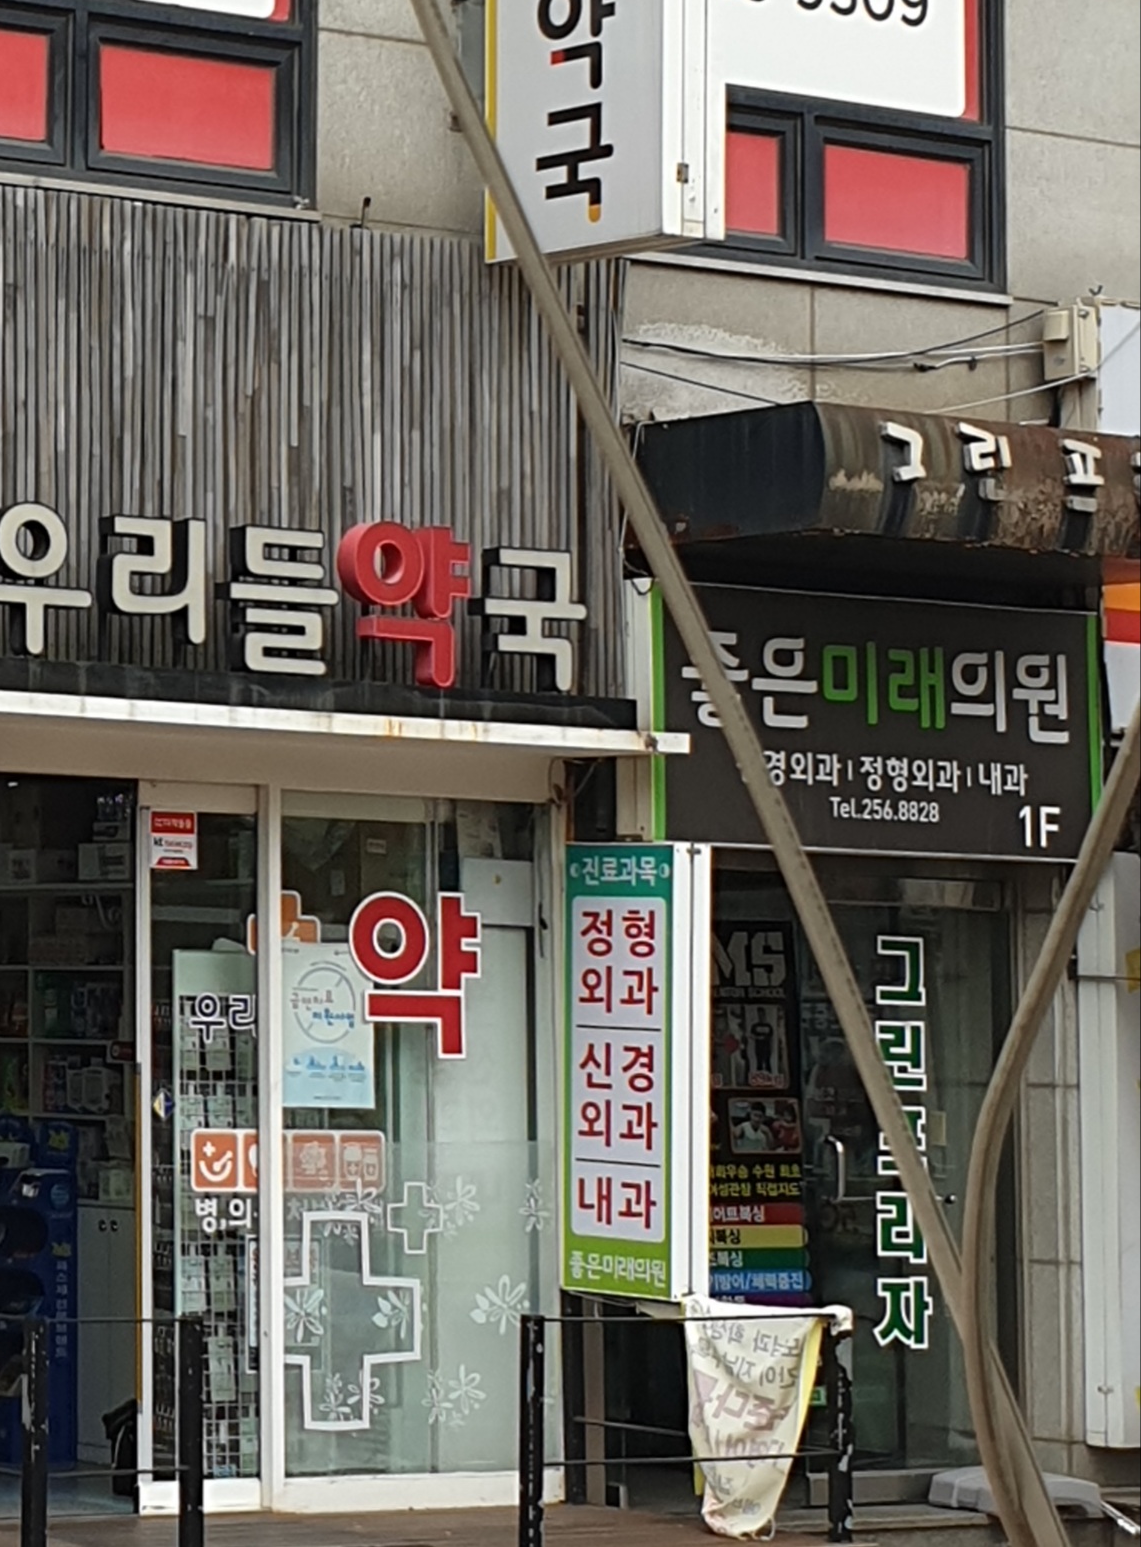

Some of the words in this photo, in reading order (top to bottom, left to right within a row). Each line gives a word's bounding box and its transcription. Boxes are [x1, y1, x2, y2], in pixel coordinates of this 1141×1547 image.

[740, 749, 840, 788] 경외과
[860, 756, 960, 794] 정형외과
[978, 764, 1028, 797] 내과
[1018, 806, 1060, 848] 1F
[582, 856, 658, 886] 진료과목
[580, 909, 655, 958] 정형
[349, 891, 481, 1059] 약
[578, 965, 659, 1015] 외과
[579, 1042, 655, 1093] 신경
[578, 1099, 658, 1150] 외과
[578, 1177, 657, 1229] 내과
[712, 1205, 765, 1223] 어트복싱
